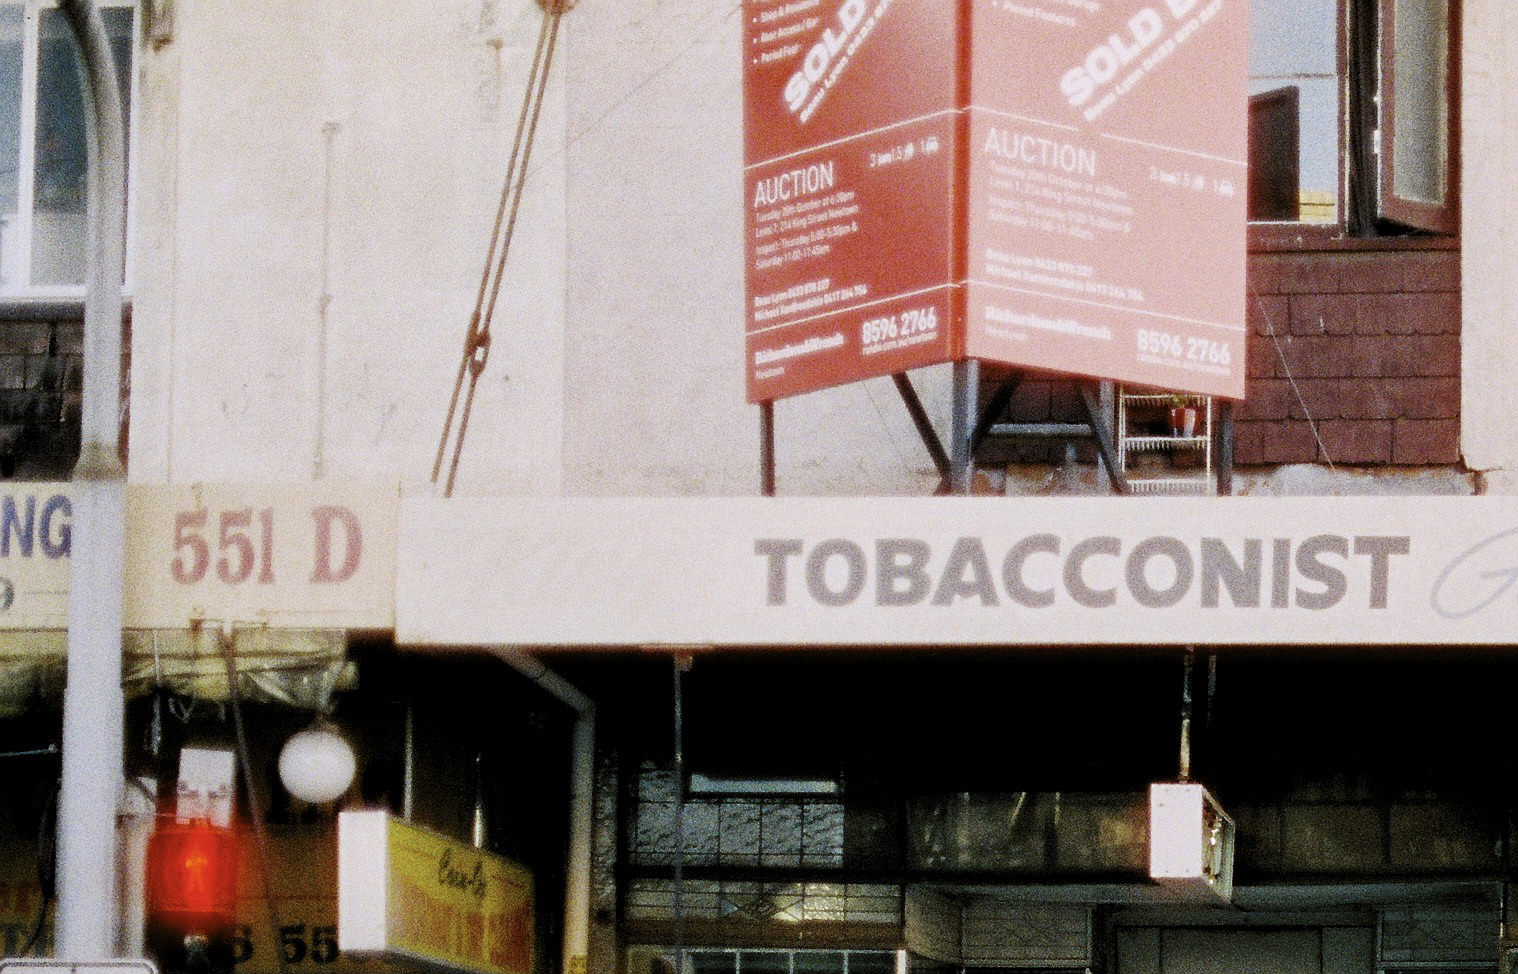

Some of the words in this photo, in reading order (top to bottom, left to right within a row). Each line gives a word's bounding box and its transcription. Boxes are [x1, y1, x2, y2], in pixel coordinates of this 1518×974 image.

[784, 0, 867, 112] SOLD
[1060, 8, 1165, 107] SOLD
[984, 127, 1097, 176] AUCTION
[754, 161, 835, 208] AUCTION
[862, 316, 899, 345] 8596
[900, 307, 937, 336] 2766
[1137, 328, 1183, 358] 8596
[1187, 336, 1231, 366] 2766
[0, 494, 72, 558] NG
[171, 506, 274, 585] 551
[309, 506, 363, 585] D
[754, 533, 1411, 611] TOBACCONIST
